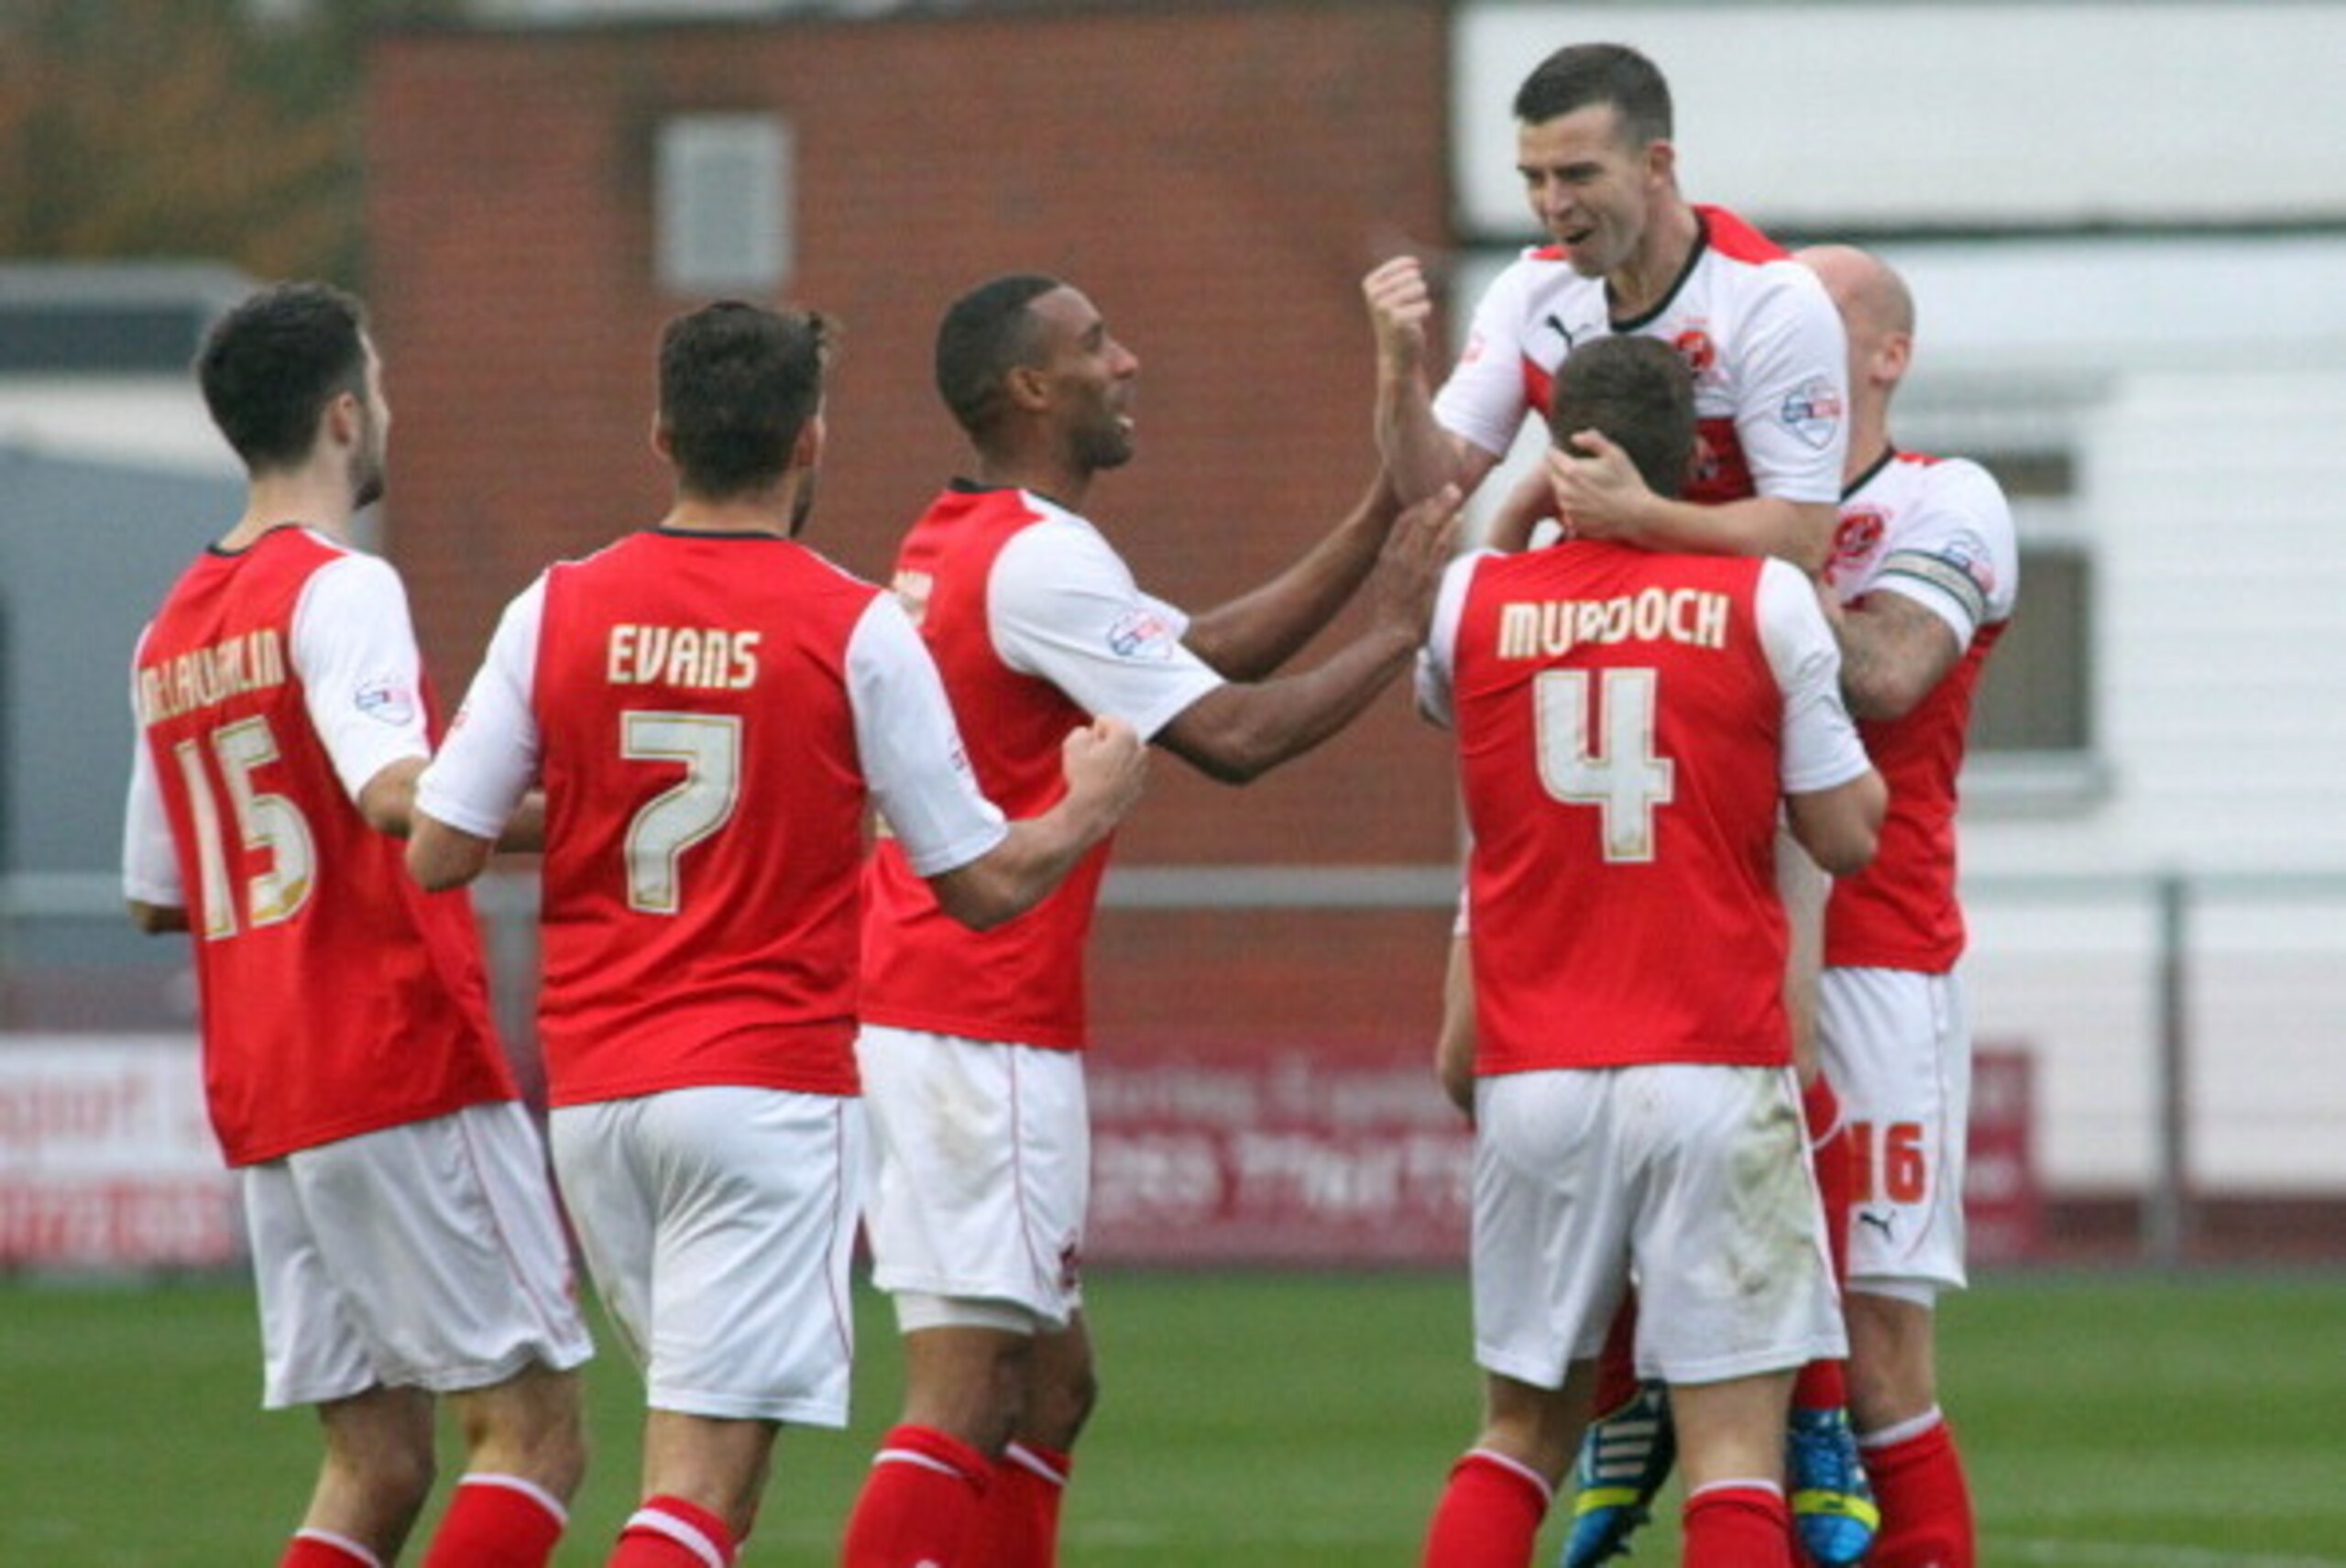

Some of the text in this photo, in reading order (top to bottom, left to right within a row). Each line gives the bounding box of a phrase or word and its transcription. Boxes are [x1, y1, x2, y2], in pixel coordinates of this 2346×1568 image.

[607, 624, 762, 689] EVANS
[1497, 587, 1730, 659] MURDOCH
[173, 714, 319, 942] 15
[619, 710, 743, 915] 7
[1533, 666, 1675, 863] 4
[1846, 1121, 1925, 1204] 16
